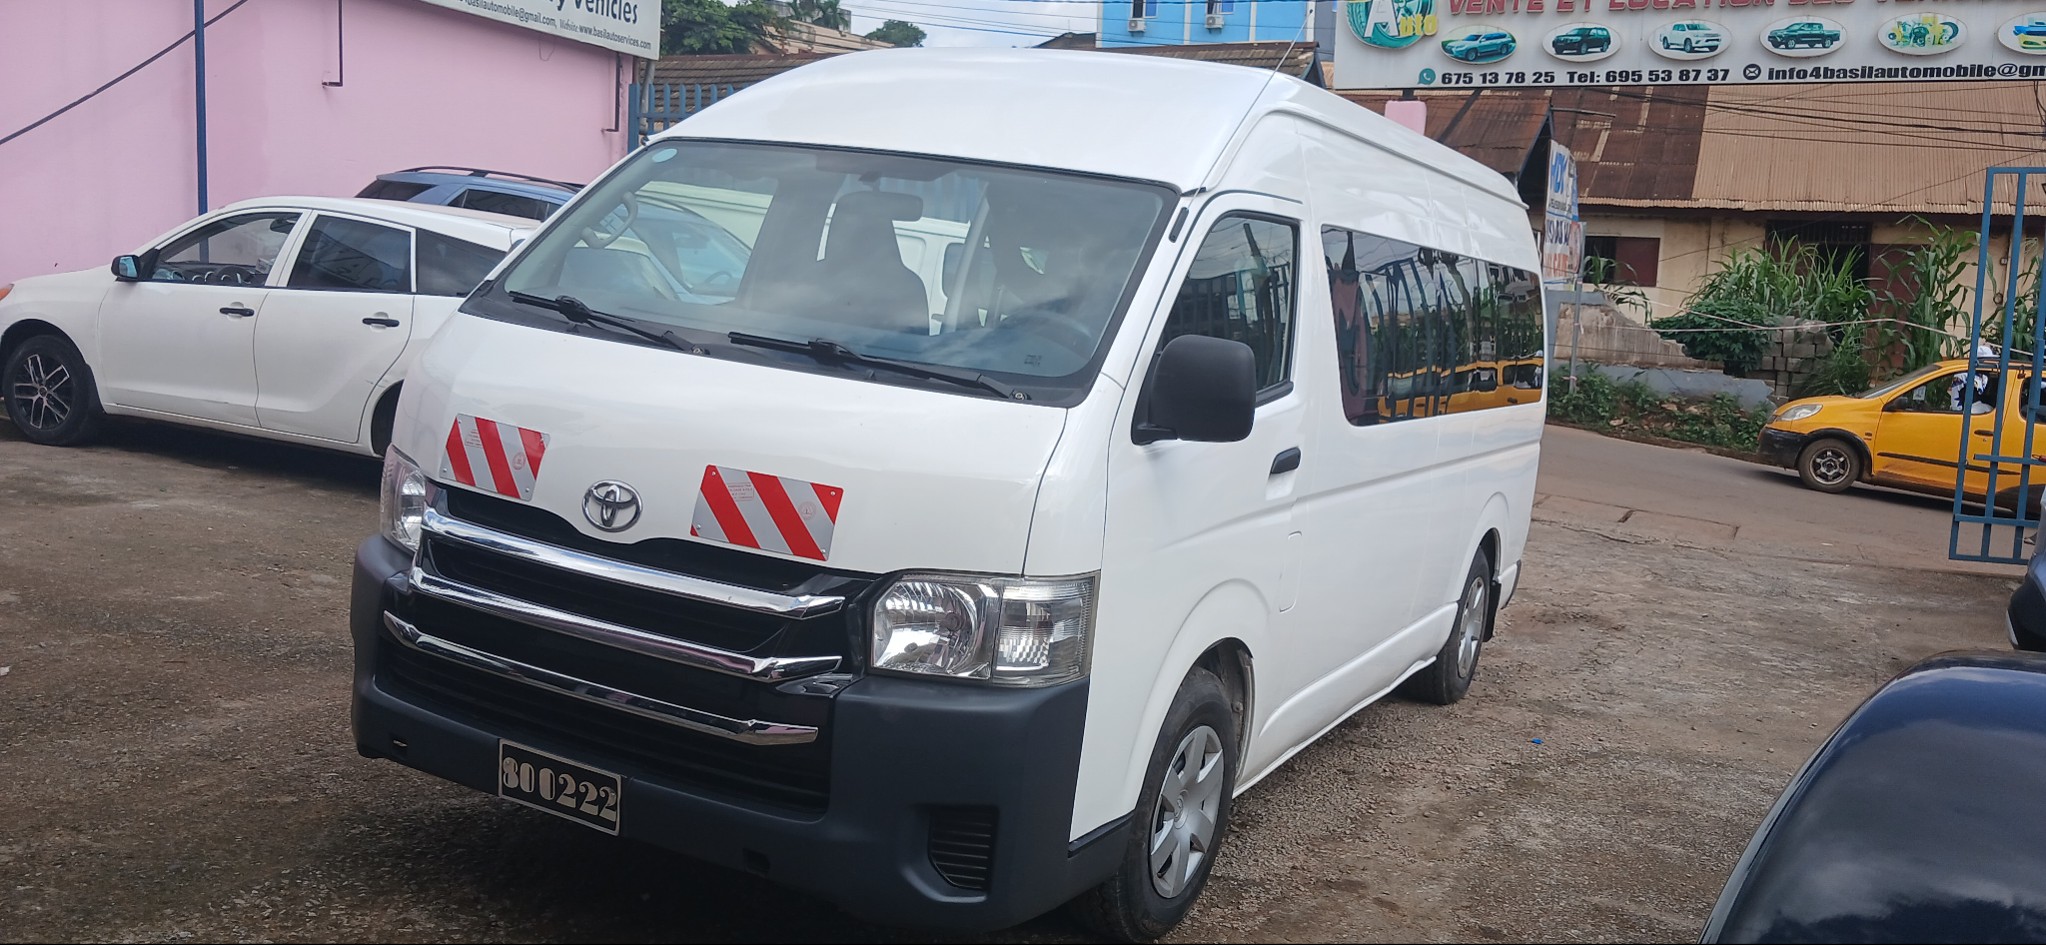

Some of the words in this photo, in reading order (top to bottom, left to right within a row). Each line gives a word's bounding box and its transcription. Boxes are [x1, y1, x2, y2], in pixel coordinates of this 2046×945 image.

[1441, 72, 1474, 85] 675
[1479, 72, 1499, 84] 13
[1505, 71, 1526, 84] 78
[1531, 71, 1555, 84] 25
[1566, 71, 1600, 84] Tel:
[1605, 70, 1642, 83] 695
[1648, 69, 1672, 82] 53
[1678, 69, 1702, 82] 87
[1706, 68, 1730, 82] 37
[502, 756, 617, 822] 800222
